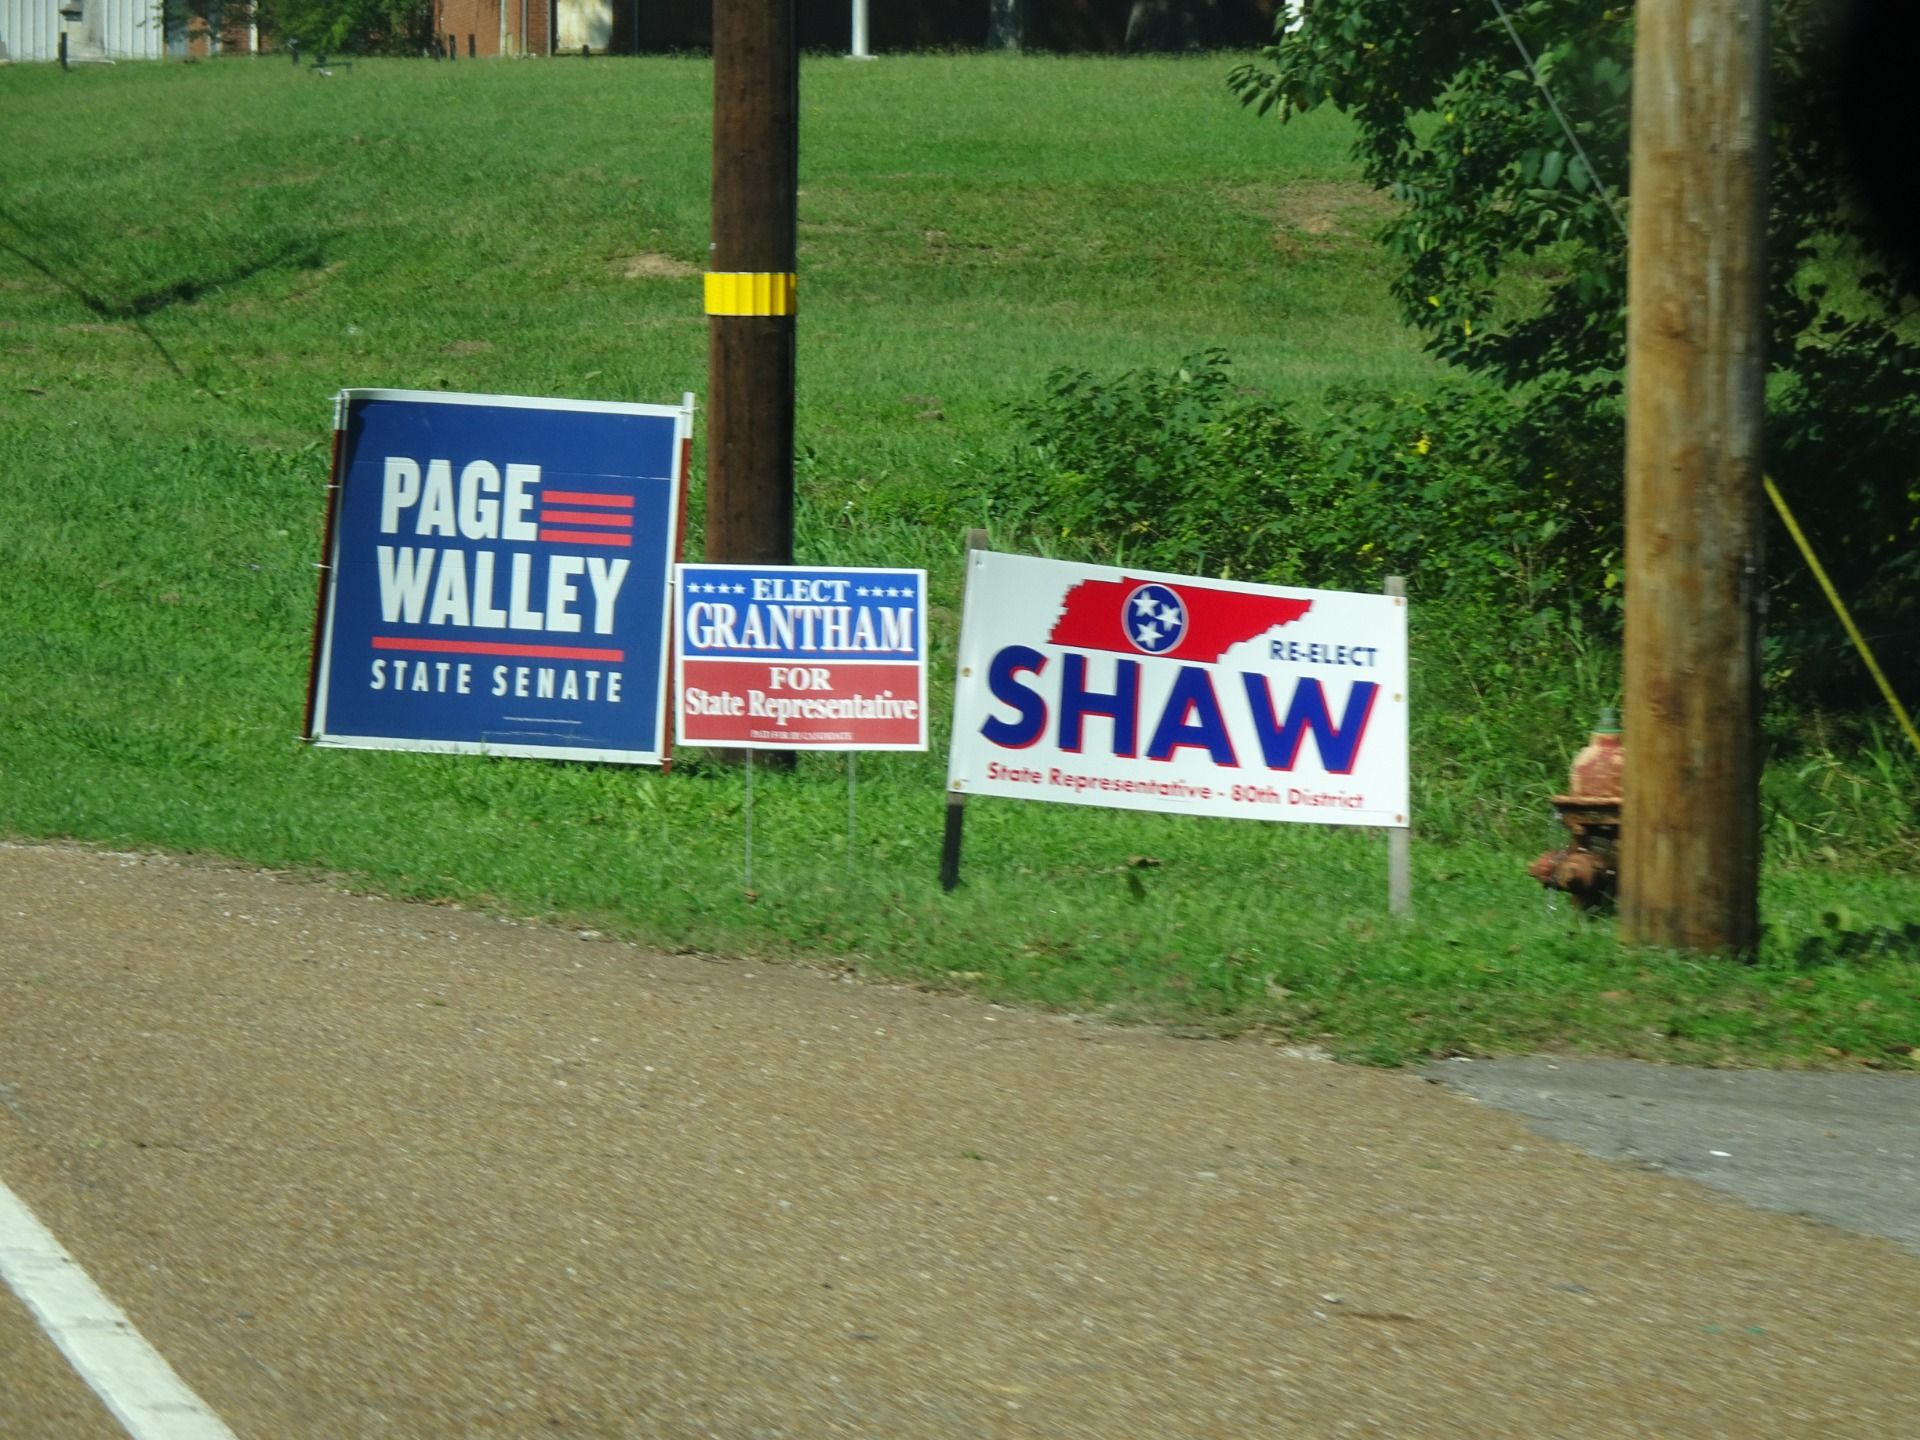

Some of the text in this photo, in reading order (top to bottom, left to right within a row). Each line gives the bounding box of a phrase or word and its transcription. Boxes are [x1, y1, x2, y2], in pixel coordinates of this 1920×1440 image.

[380, 456, 541, 541] PAGE
[376, 545, 631, 635] WALLEY
[751, 578, 850, 602] ELECT
[686, 602, 914, 652] GRANTHAM
[1269, 639, 1378, 667] RE-ELECT
[370, 659, 623, 703] STATE SENATE
[768, 667, 833, 690] FOR
[685, 687, 919, 726] State Representative
[979, 645, 1381, 775] SHAW
[986, 762, 1044, 785] State
[1048, 768, 1212, 801] Representative
[1231, 784, 1281, 805] 80th
[1290, 788, 1366, 809] District
